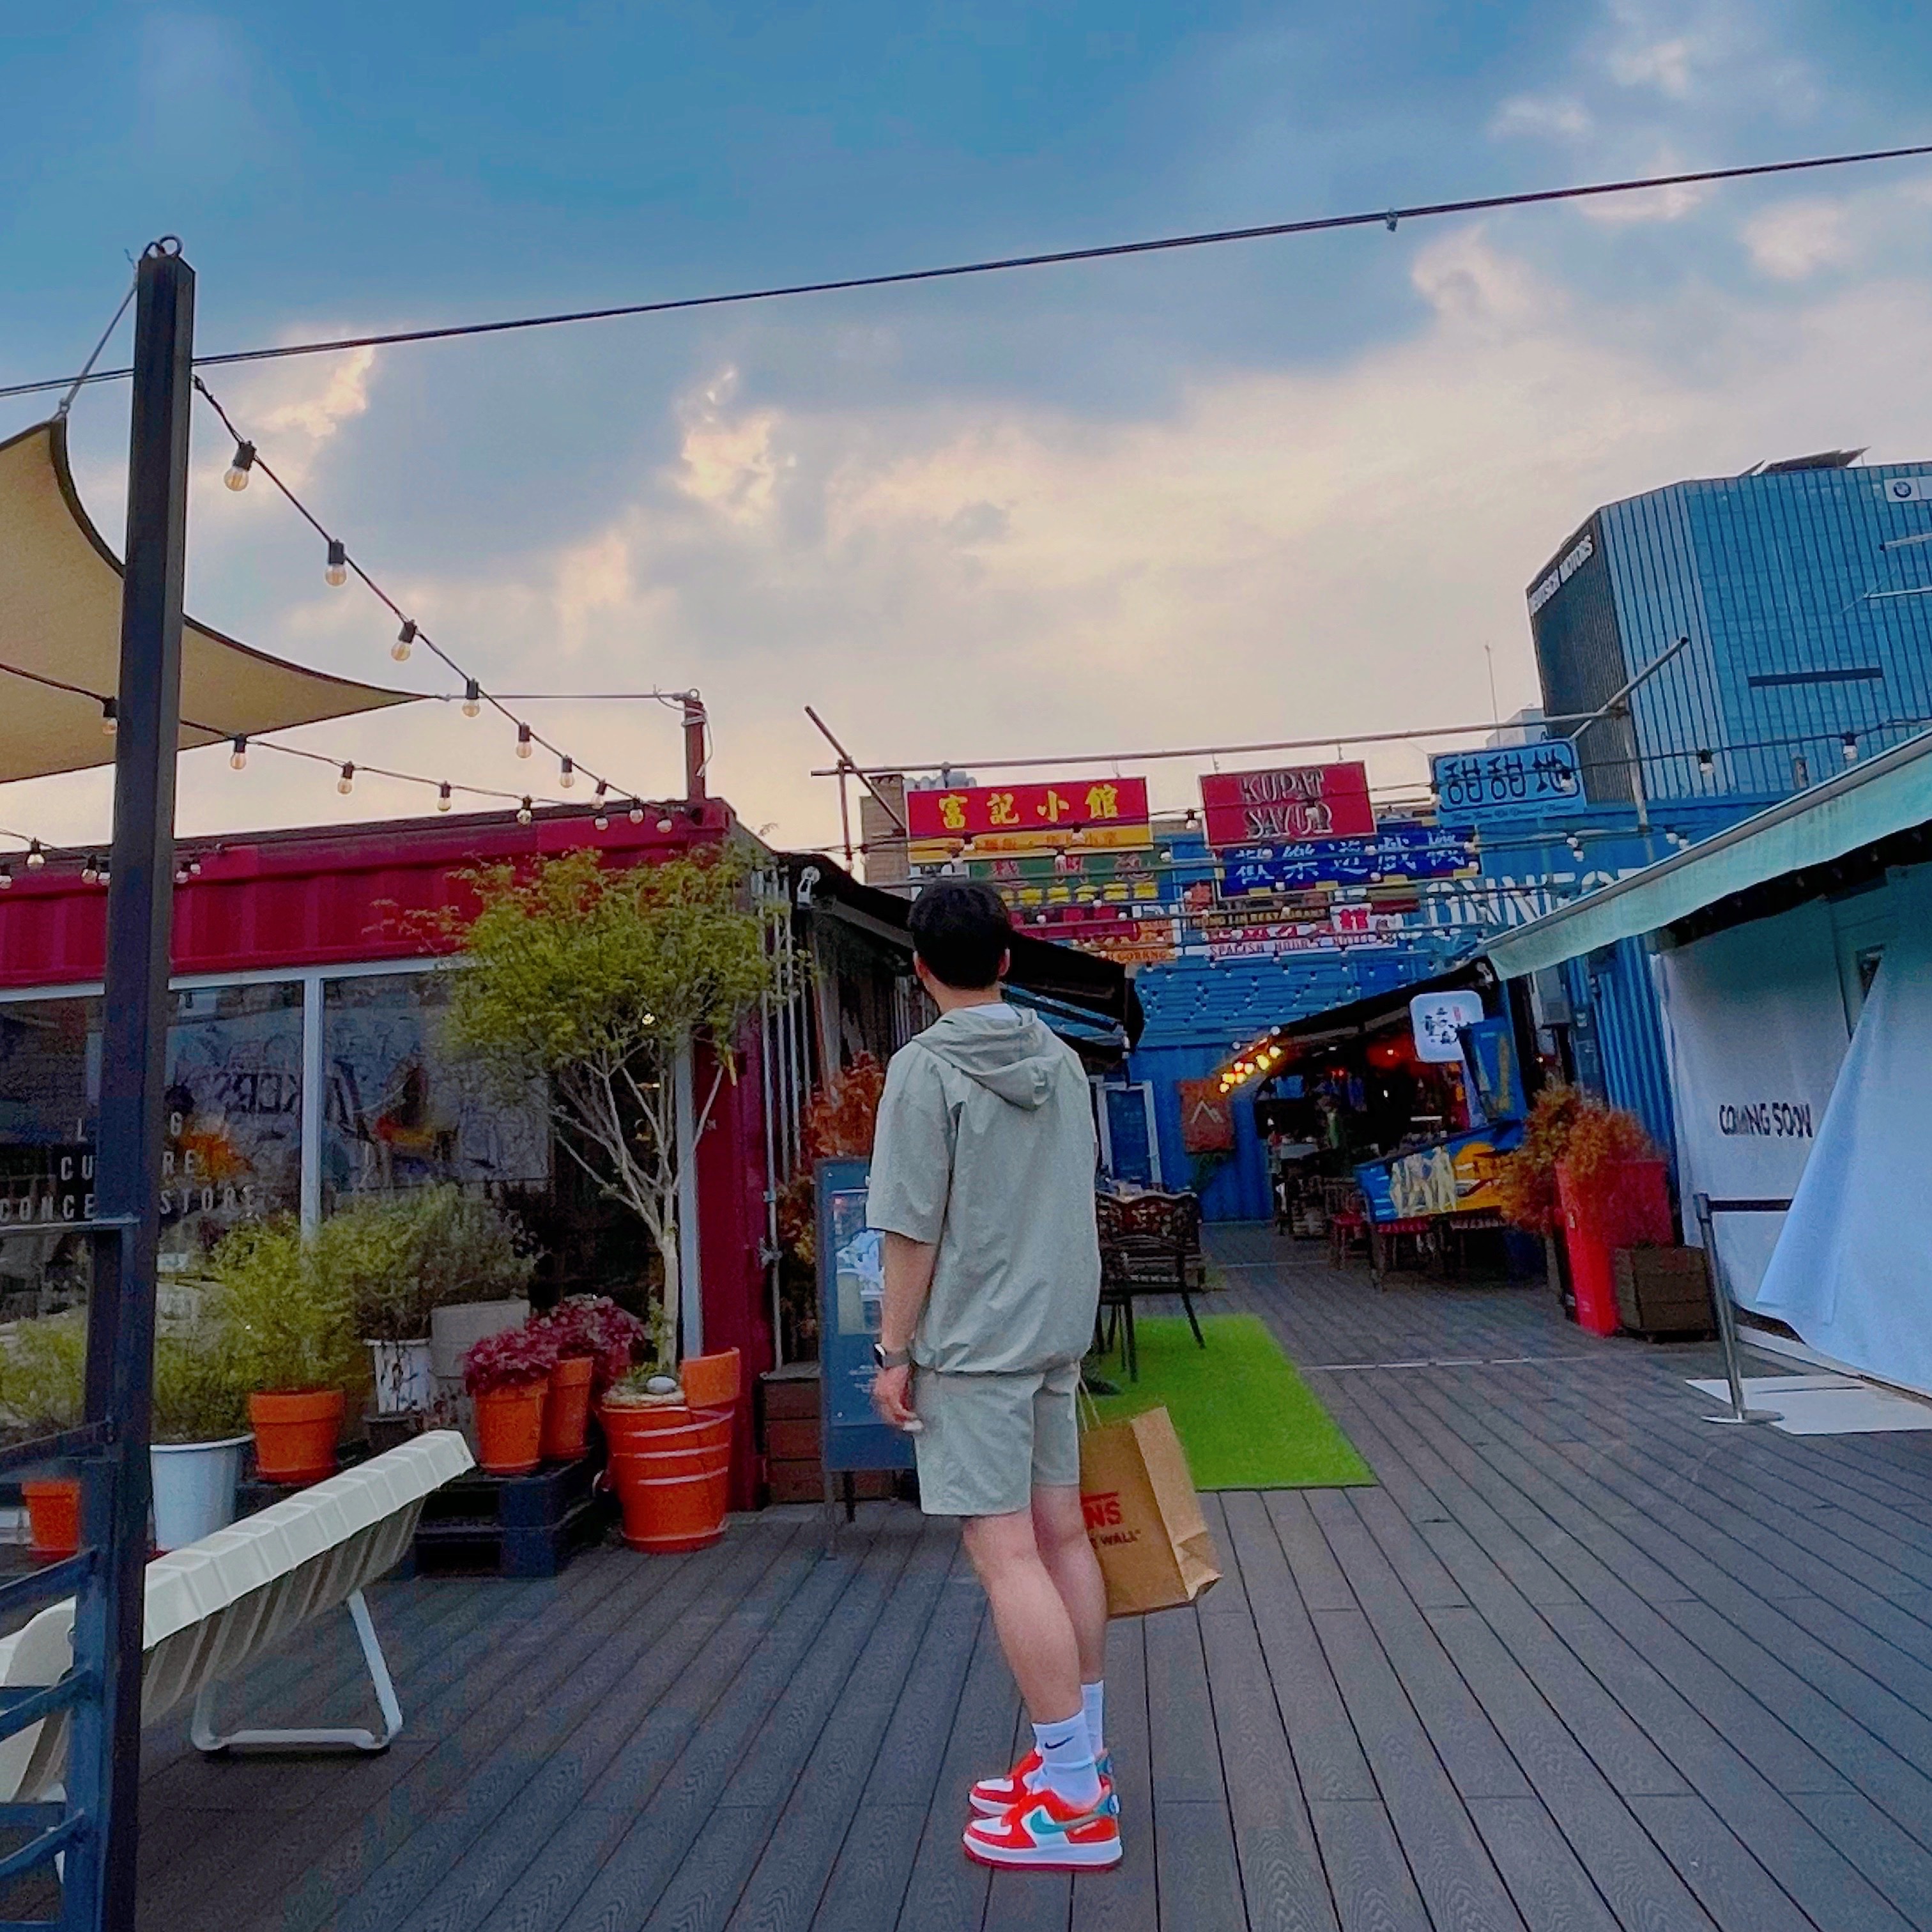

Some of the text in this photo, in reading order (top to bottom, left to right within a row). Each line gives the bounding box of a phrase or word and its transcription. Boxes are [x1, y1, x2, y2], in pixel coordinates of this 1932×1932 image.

[939, 784, 1118, 829] 富記小館
[1081, 1494, 1121, 1529] NS
